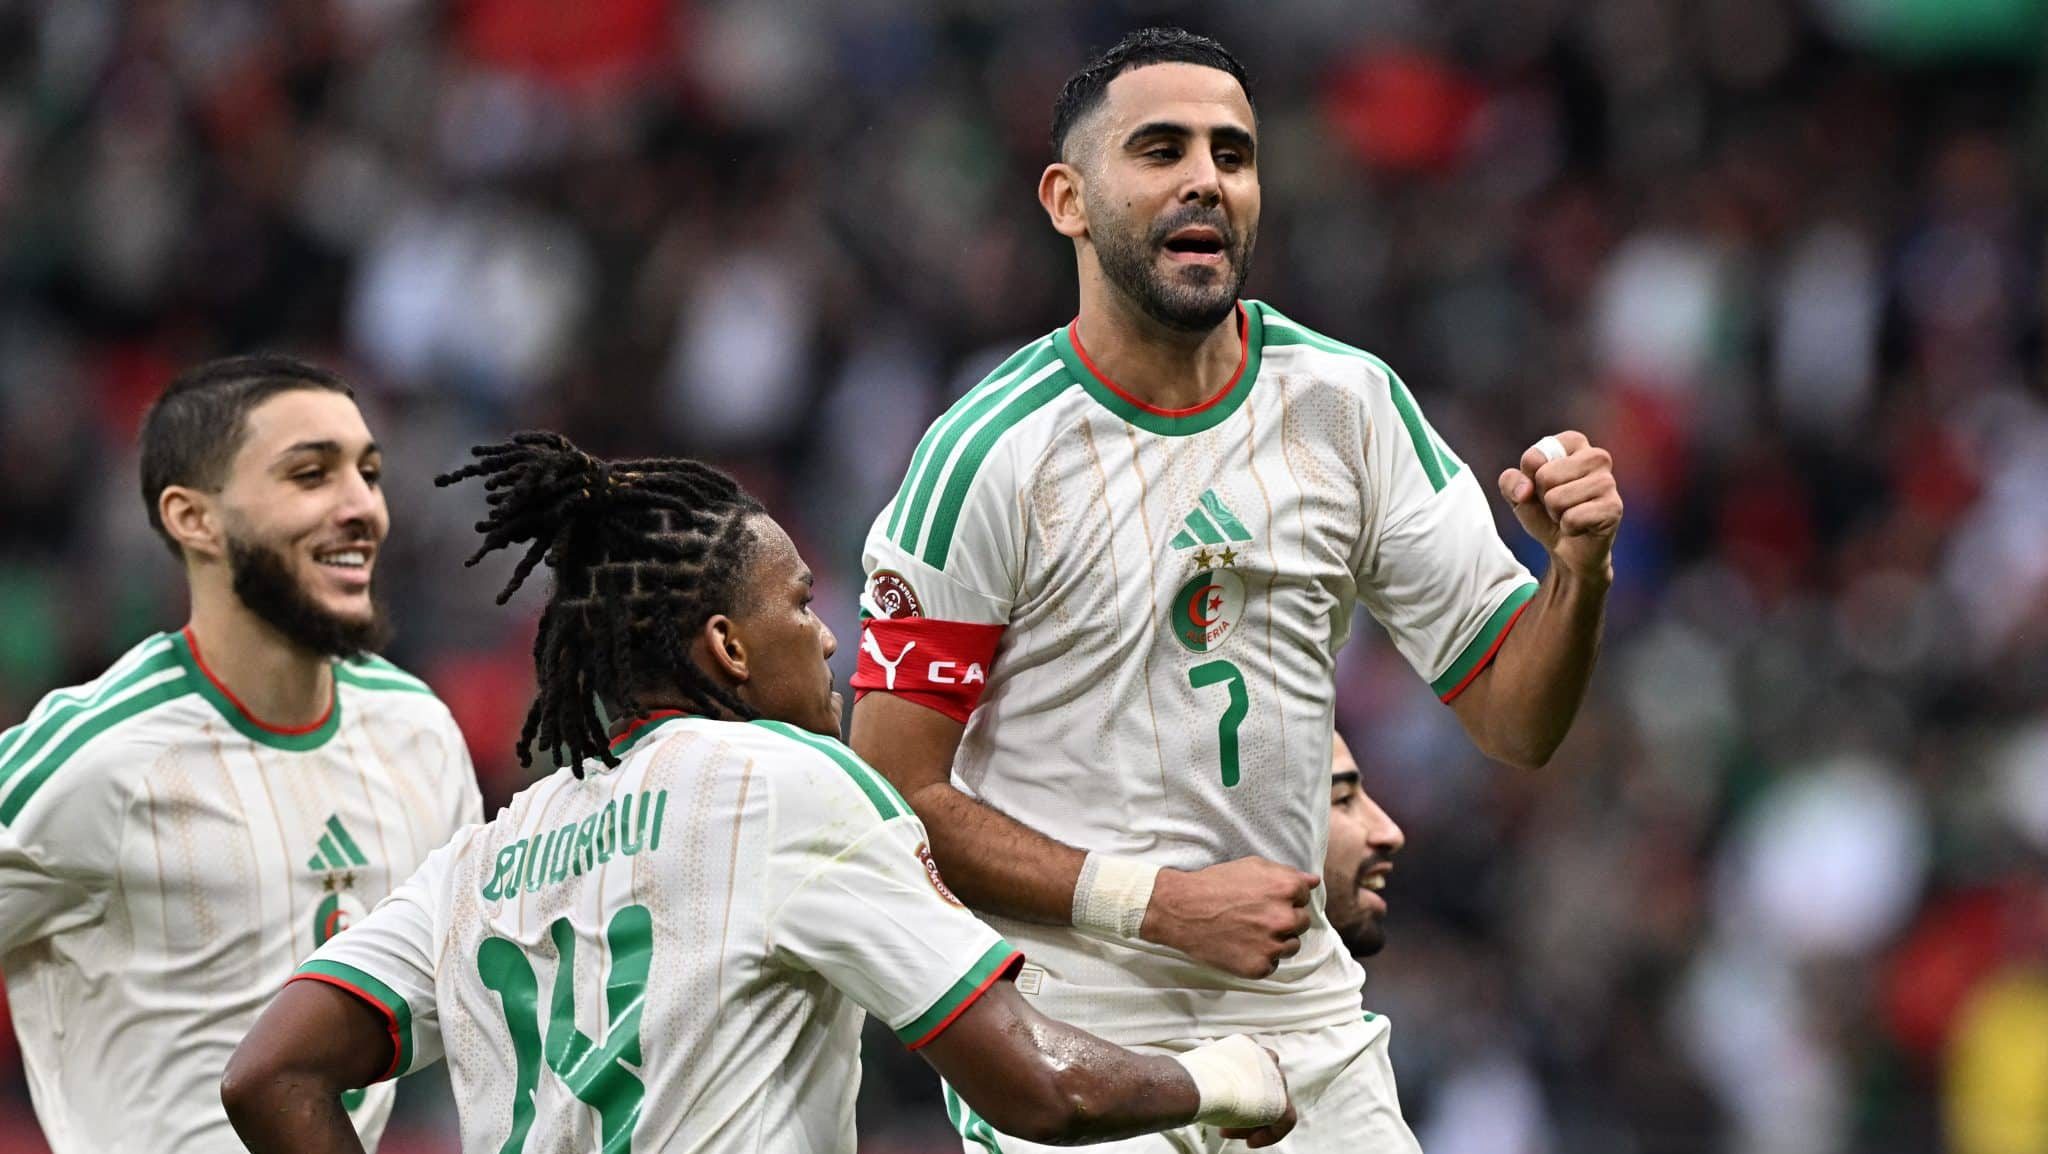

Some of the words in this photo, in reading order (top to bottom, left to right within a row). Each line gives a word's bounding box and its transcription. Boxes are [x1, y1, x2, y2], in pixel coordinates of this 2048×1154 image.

[928, 660, 988, 684] CA
[1188, 659, 1249, 787] 7
[482, 789, 668, 901] BOUDAOUI
[477, 904, 654, 1154] 14
